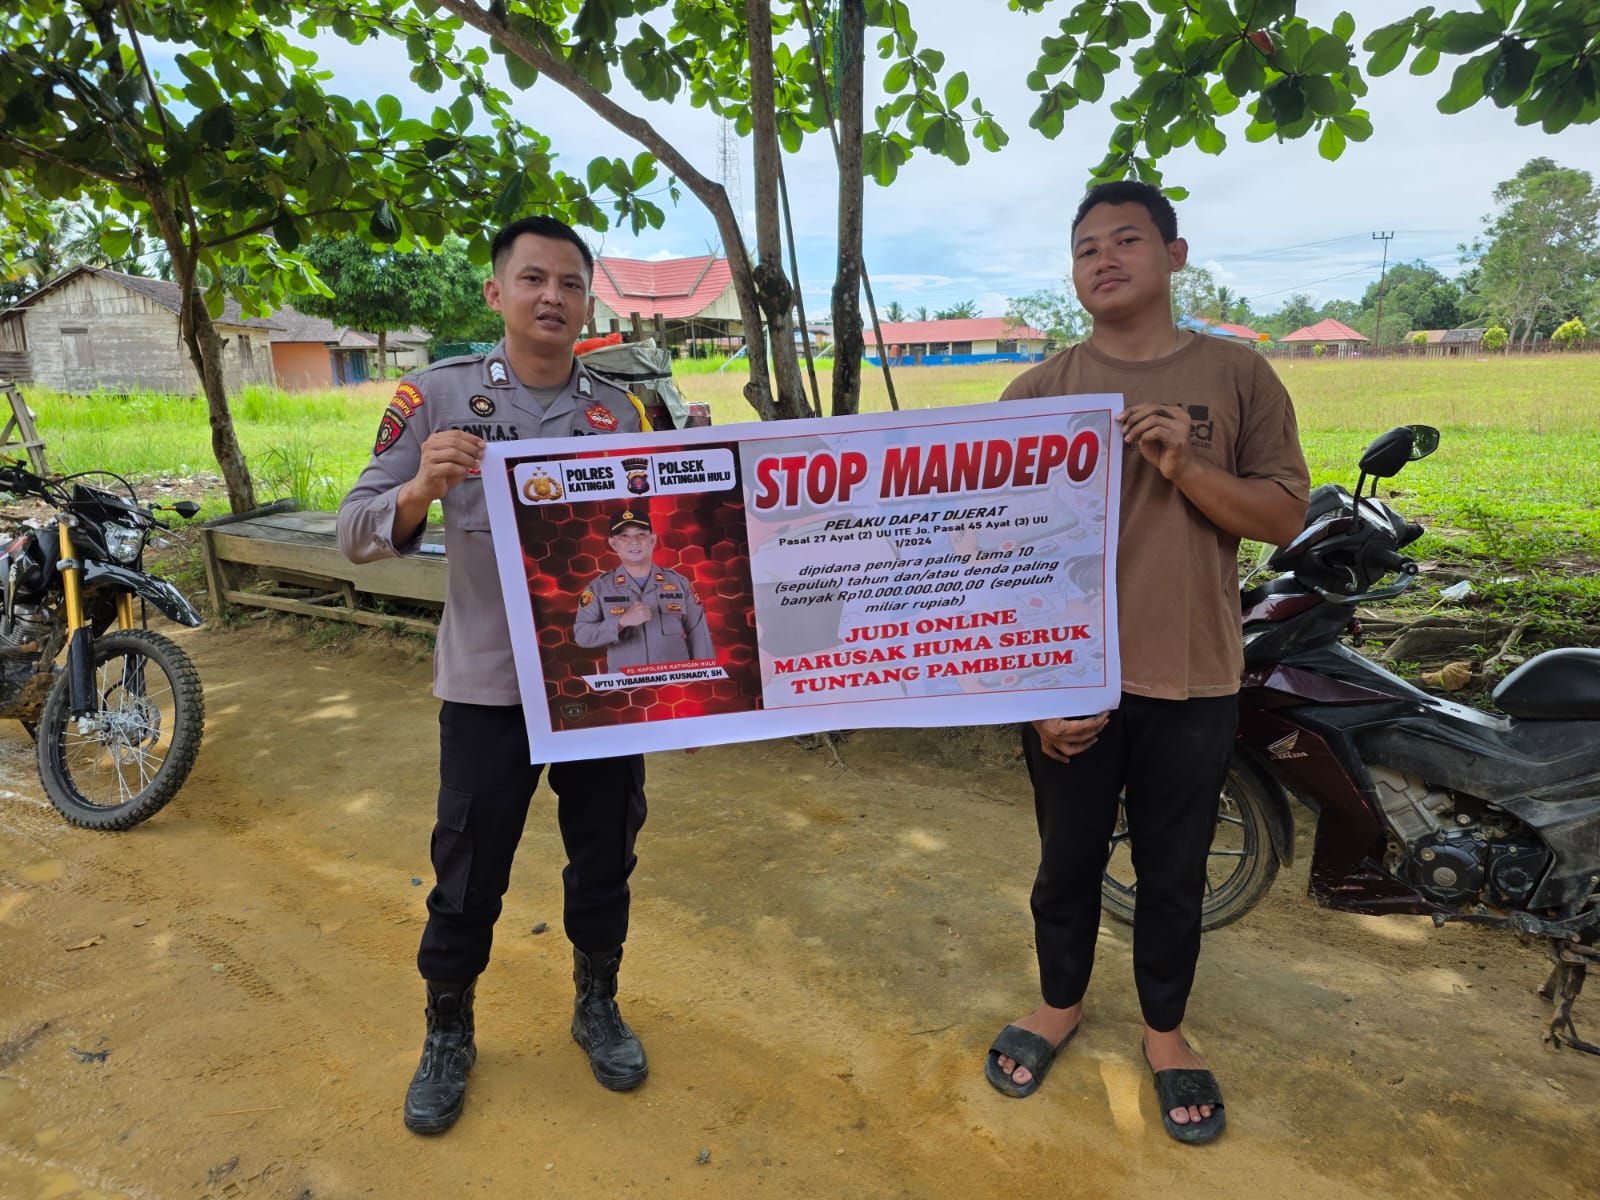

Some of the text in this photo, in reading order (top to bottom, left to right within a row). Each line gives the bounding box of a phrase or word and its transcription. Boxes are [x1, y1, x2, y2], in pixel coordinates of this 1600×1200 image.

[566, 466, 613, 482] POLRES
[658, 460, 704, 474] POLSEK
[659, 471, 731, 486] KATINGAN HULU
[755, 430, 1099, 510] STOP MANDEPO
[568, 480, 615, 493] KATINGAN
[779, 516, 1048, 546] Pasal 27 Ayat (2) UU ITE Jo. Pasal 45 Ayat (3) UU
[824, 505, 1008, 531] PELAKU DAPAT DIJERAT
[895, 537, 932, 548] 1/2024
[799, 546, 1034, 577] dipidana penjara paling lama 10
[775, 560, 1059, 594] (sepuluh) tahun dan/atau denda paling
[780, 574, 1054, 607] banyak Rp10.000.000.000,00 (sepuluh
[865, 595, 966, 613] miliar rupiah)
[845, 609, 1018, 643] JUDI ONLINE
[774, 624, 1091, 675] MARUSAK HUMA SERUK
[594, 669, 722, 688] IPTU YUBAMBANG KUSNADY, SH
[791, 649, 1074, 695] TUNTANG PAMBELUM
